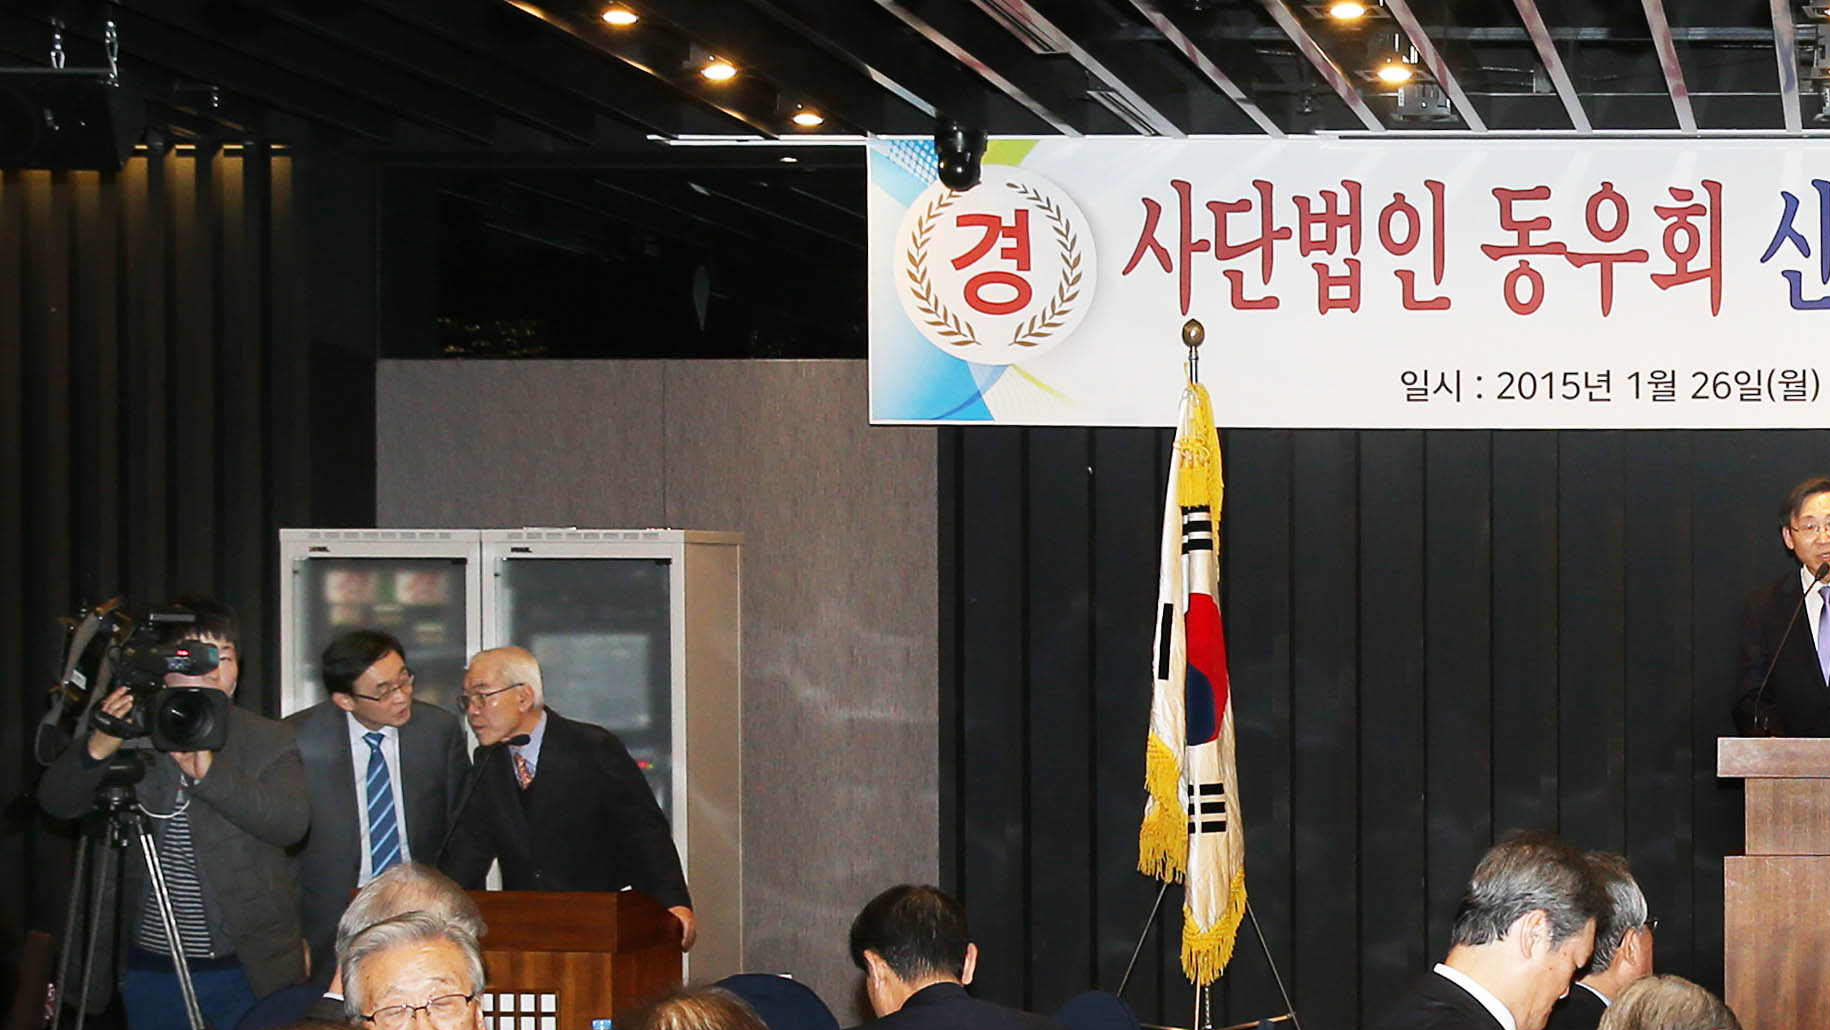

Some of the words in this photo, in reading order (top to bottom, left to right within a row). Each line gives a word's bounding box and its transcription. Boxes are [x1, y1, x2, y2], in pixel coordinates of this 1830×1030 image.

[952, 210, 1032, 314] 경
[1122, 179, 1451, 317] 사단법인
[1480, 179, 1722, 317] 동우회
[1400, 369, 1461, 403] 일시
[1496, 369, 1612, 403] 2015년
[1627, 369, 1676, 403] 1월
[1690, 367, 1820, 403] 26일(월)
